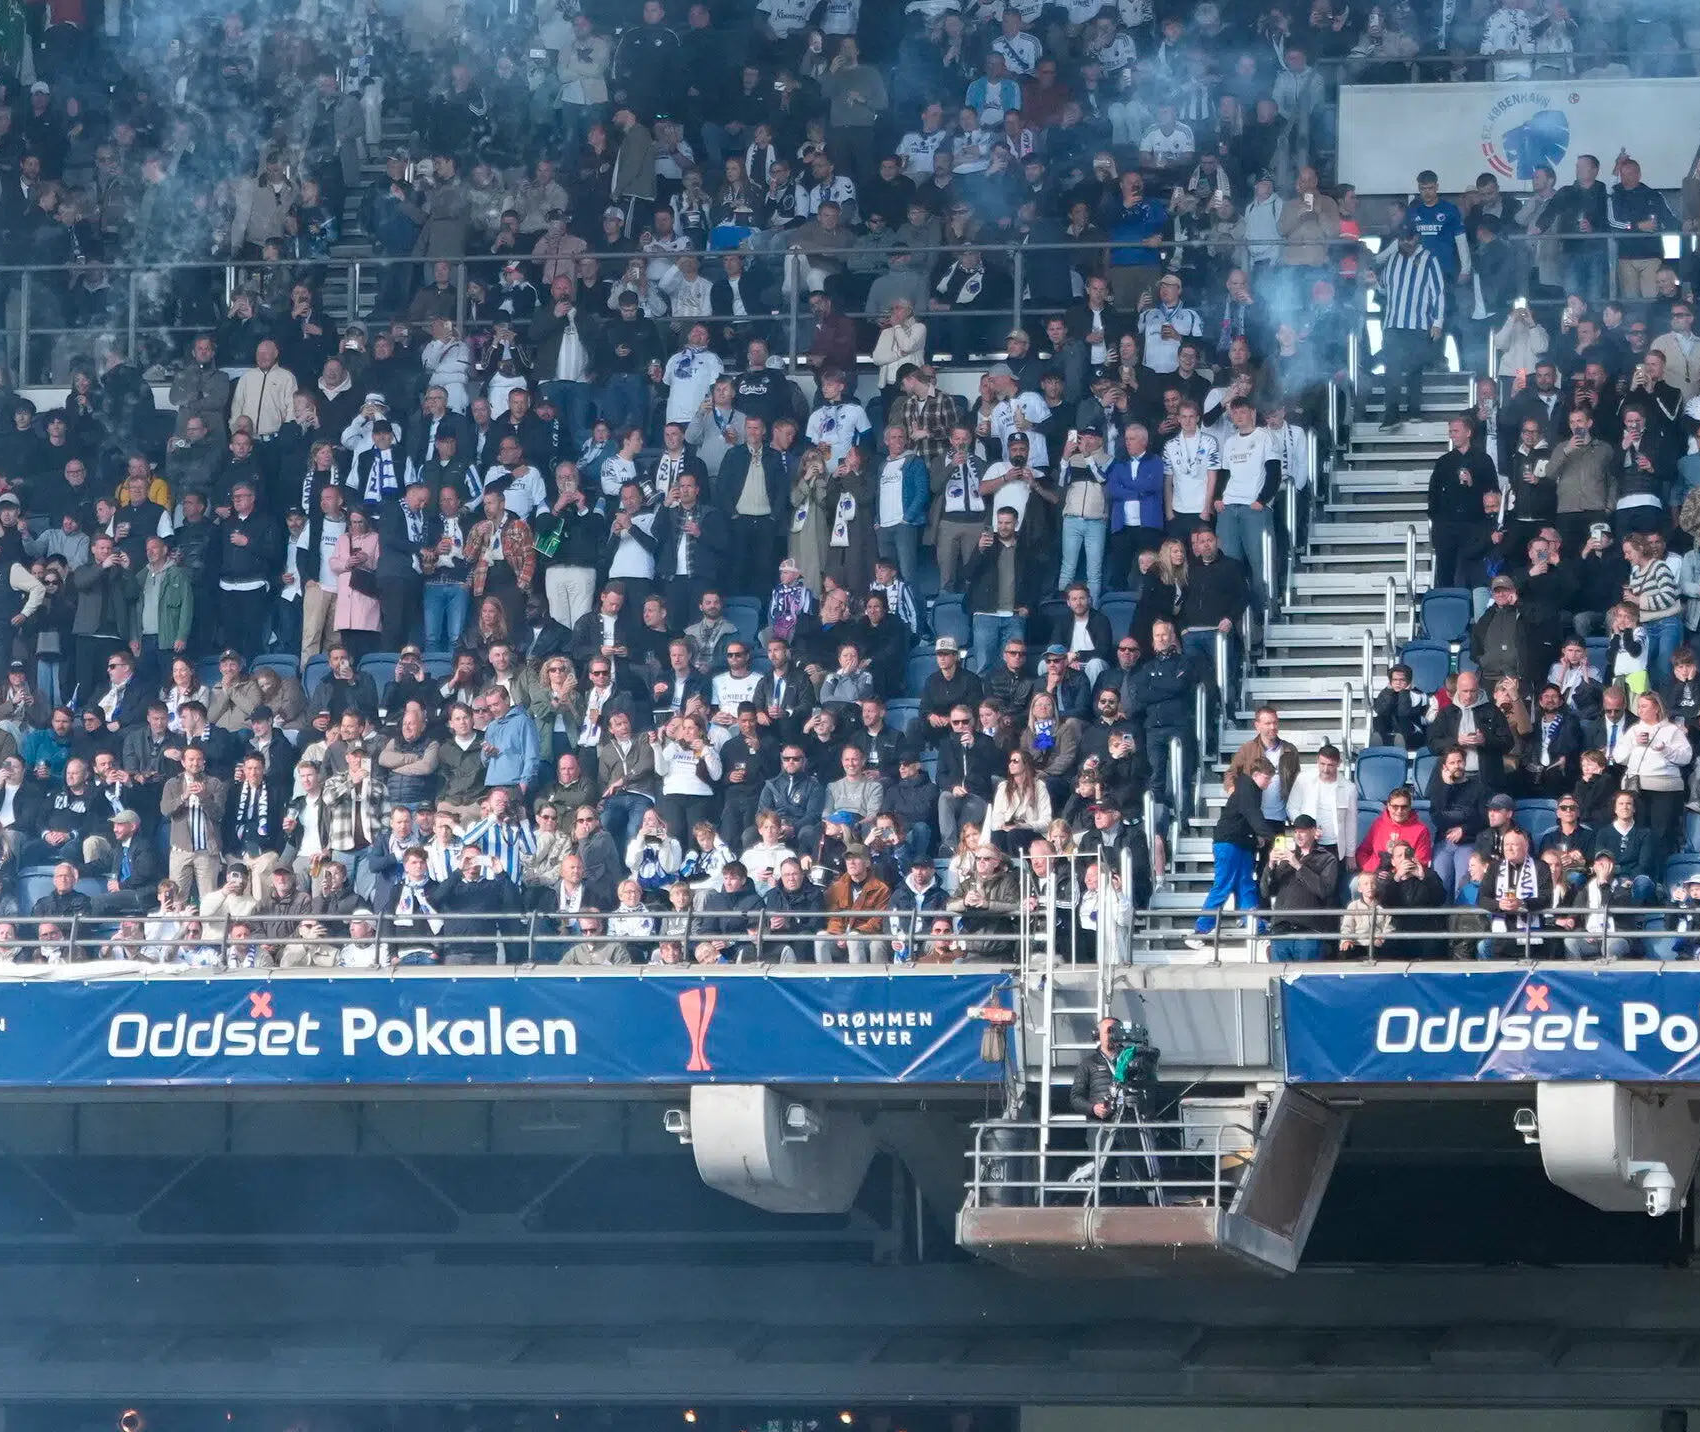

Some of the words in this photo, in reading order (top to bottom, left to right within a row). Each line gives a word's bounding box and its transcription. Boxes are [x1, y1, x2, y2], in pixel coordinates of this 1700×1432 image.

[1416, 224, 1443, 232] UNIBET
[738, 384, 768, 395] Carlsberg
[822, 1012, 932, 1027] DRØMMEN
[108, 1012, 321, 1057] Oddset
[342, 1006, 578, 1056] Pokalen
[1376, 1006, 1600, 1053] Oddset
[844, 1030, 911, 1045] LEVER
